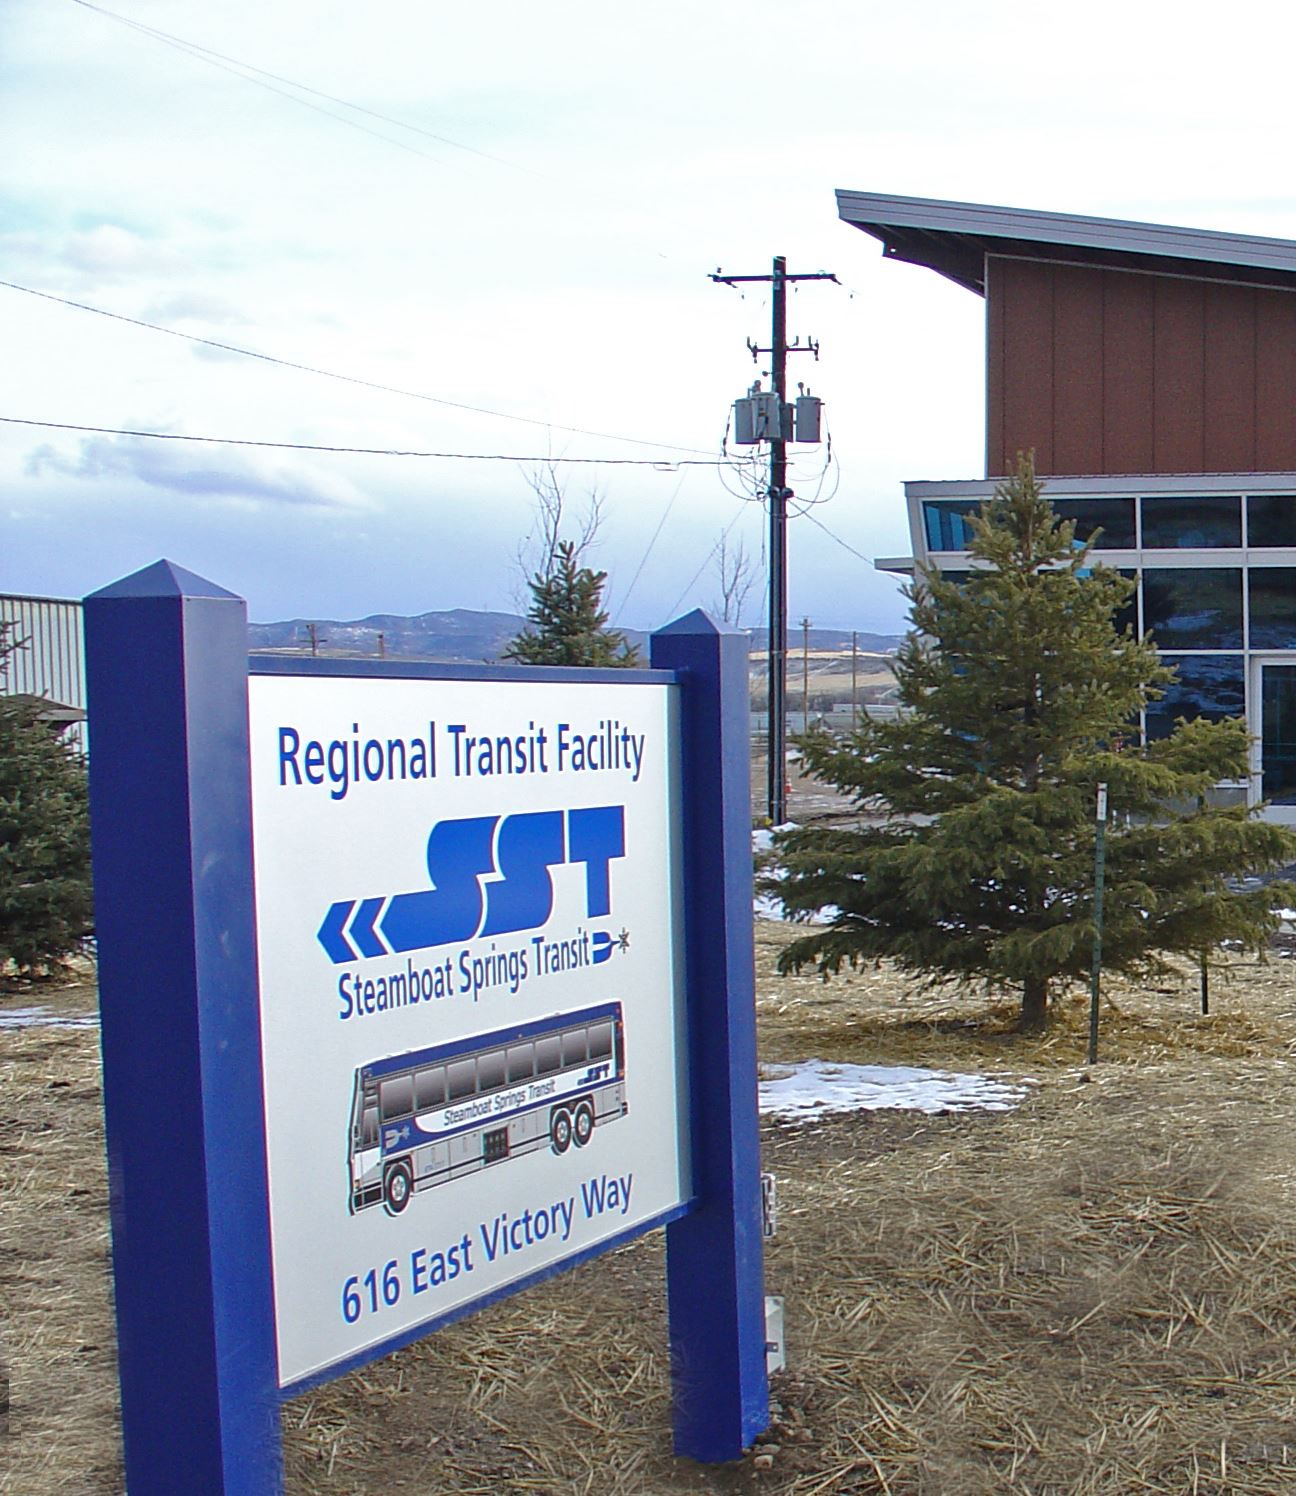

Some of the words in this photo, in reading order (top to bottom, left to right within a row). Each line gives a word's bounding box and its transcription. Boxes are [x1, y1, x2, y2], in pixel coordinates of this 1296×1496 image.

[278, 721, 437, 801] Regional
[447, 720, 548, 777] Transit
[557, 719, 645, 782] Facility
[379, 805, 626, 954] SST
[338, 959, 455, 1020] Steamboat
[458, 941, 529, 1001] Springs
[531, 927, 590, 976] Transit
[443, 1100, 492, 1126] Steamboat
[494, 1089, 527, 1111] Springs
[528, 1080, 556, 1099] Transit
[341, 1259, 402, 1323] 616
[411, 1233, 474, 1295] East
[479, 1197, 576, 1262] Victory
[581, 1173, 633, 1219] Way
